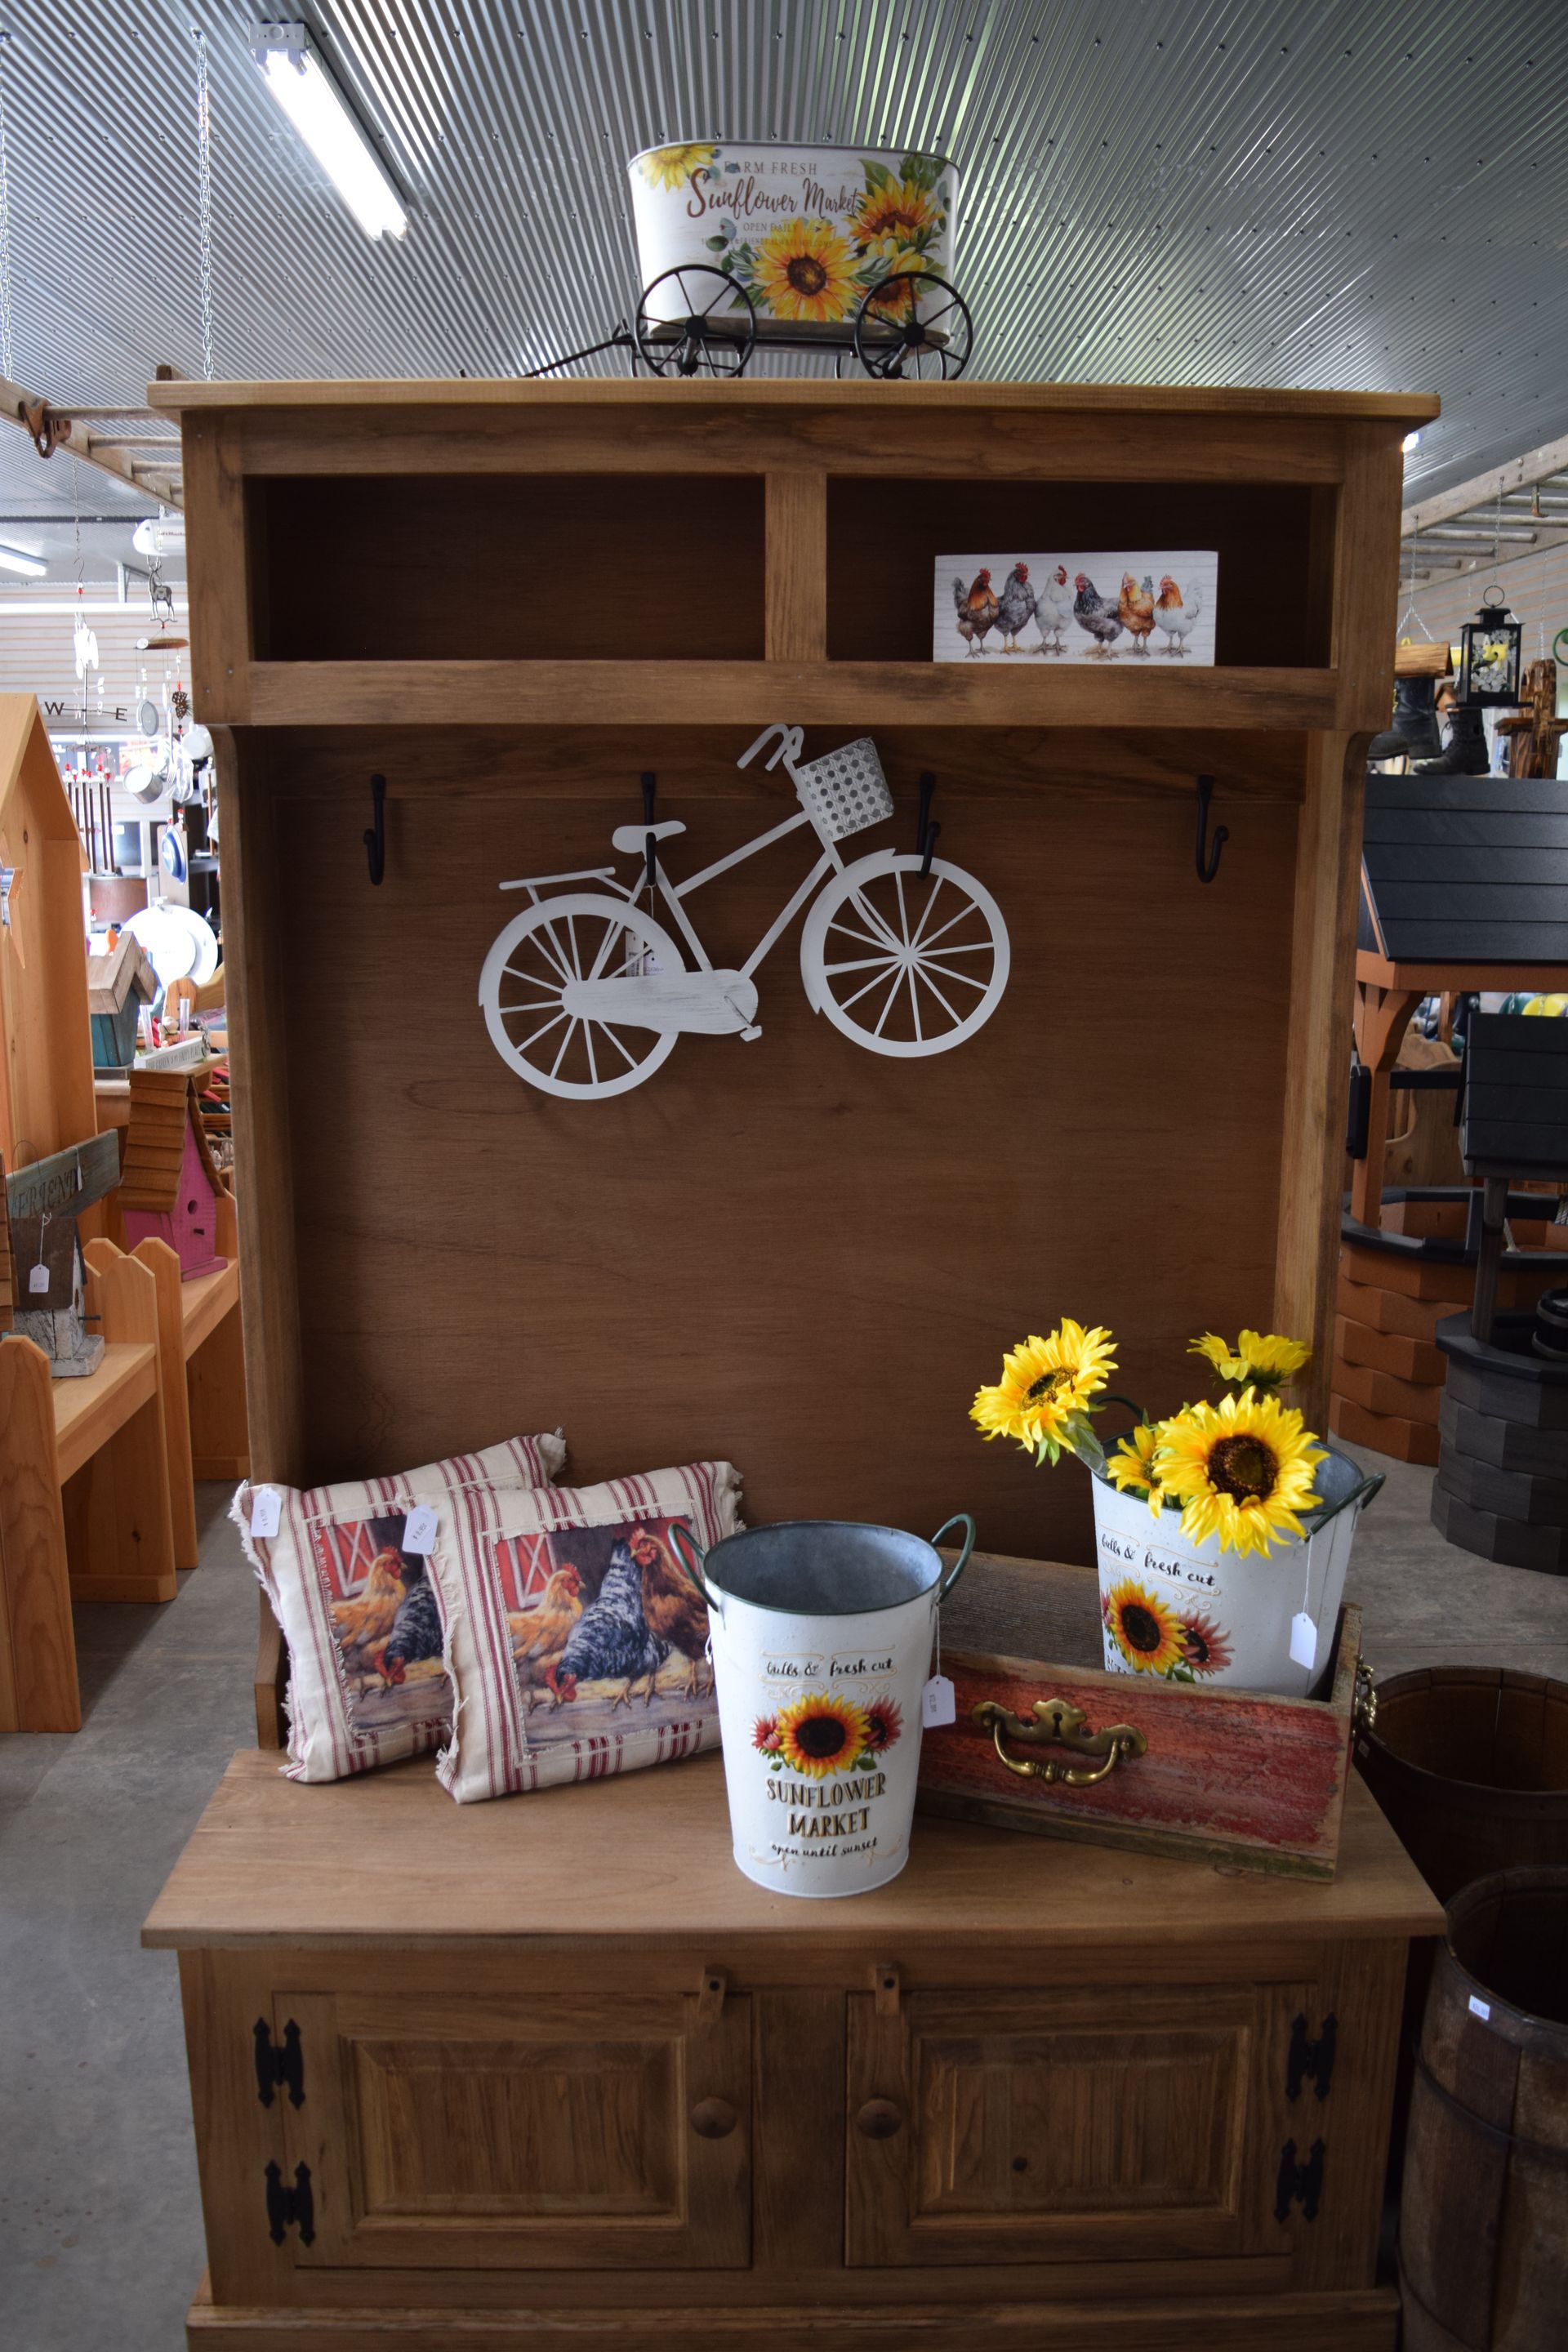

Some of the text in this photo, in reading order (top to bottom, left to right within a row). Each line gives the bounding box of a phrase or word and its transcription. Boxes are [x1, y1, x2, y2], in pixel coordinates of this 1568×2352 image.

[724, 161, 817, 176] FARM FRESH
[687, 167, 858, 220] Sunflower Market
[742, 222, 797, 234] OPEN DAILY
[44, 701, 65, 715] W
[116, 707, 127, 721] E
[1124, 1545, 1137, 1560] &
[1144, 1552, 1181, 1576] fresh
[1187, 1572, 1215, 1586] cut
[804, 1661, 819, 1676] &
[829, 1658, 866, 1677] fresh
[871, 1657, 893, 1671] cut
[765, 1771, 886, 1808] SUNFLOWER
[787, 1806, 871, 1838] MARKET
[771, 1837, 878, 1858] open until sunset
